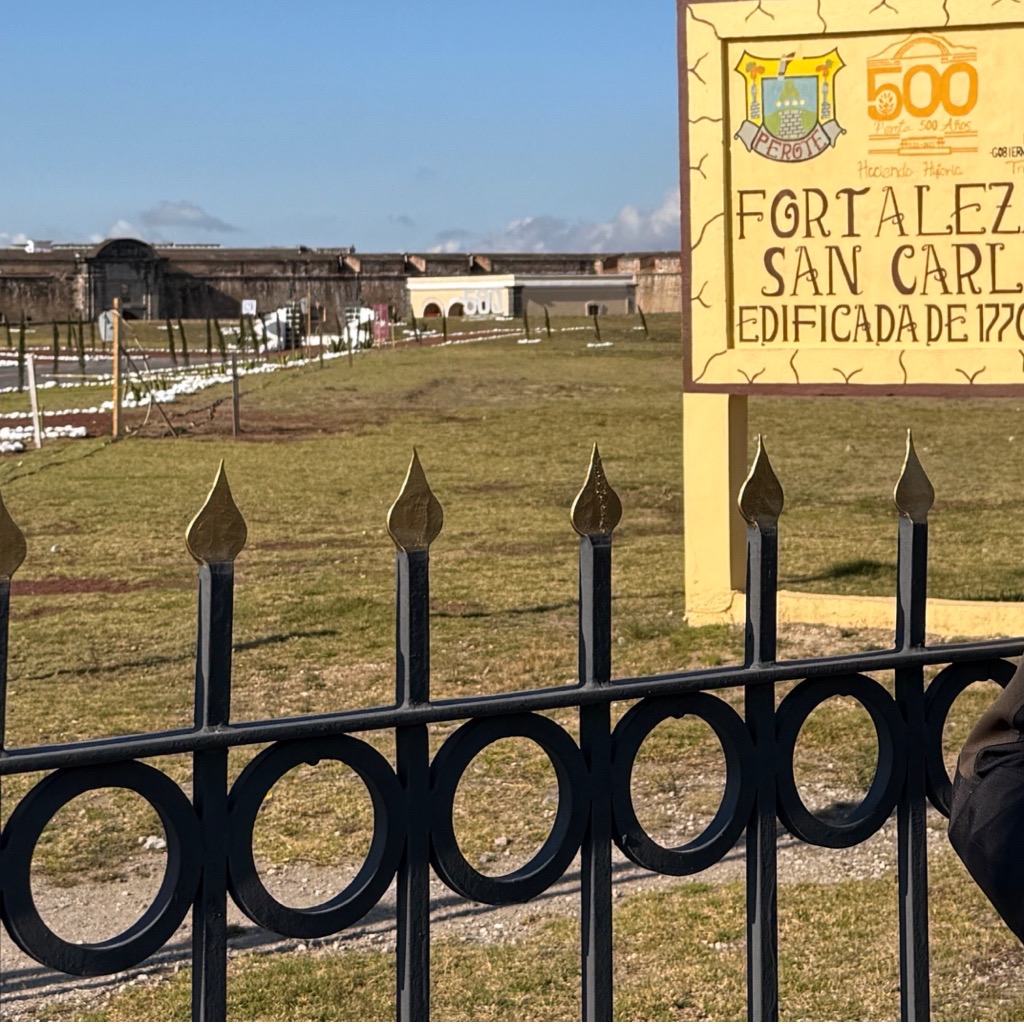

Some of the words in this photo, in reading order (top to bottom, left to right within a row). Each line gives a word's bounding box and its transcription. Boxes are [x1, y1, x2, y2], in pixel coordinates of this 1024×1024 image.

[867, 62, 979, 121] 500
[755, 129, 828, 160] PEROTE
[761, 245, 863, 297] SAN
